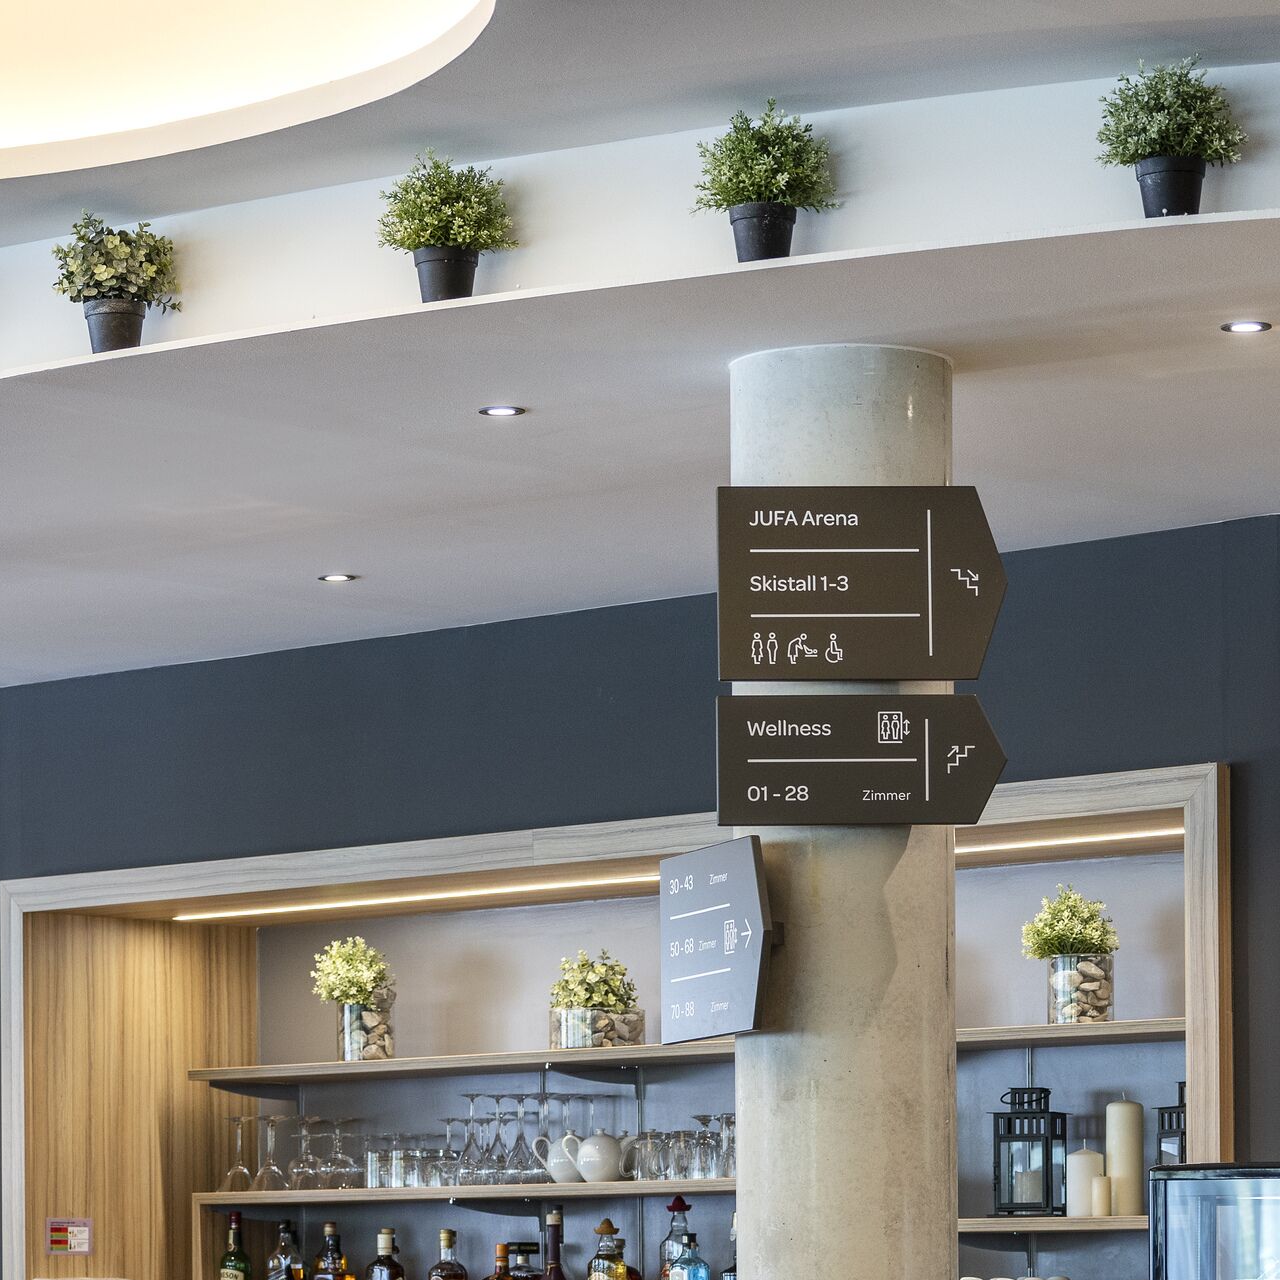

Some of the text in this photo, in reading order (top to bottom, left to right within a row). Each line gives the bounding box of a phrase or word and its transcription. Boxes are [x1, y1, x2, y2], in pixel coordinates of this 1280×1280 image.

[749, 510, 859, 527] JUFA Arena
[749, 574, 849, 592] Skistall 1-3
[747, 719, 832, 737] Wellness
[862, 789, 911, 801] Zimmer
